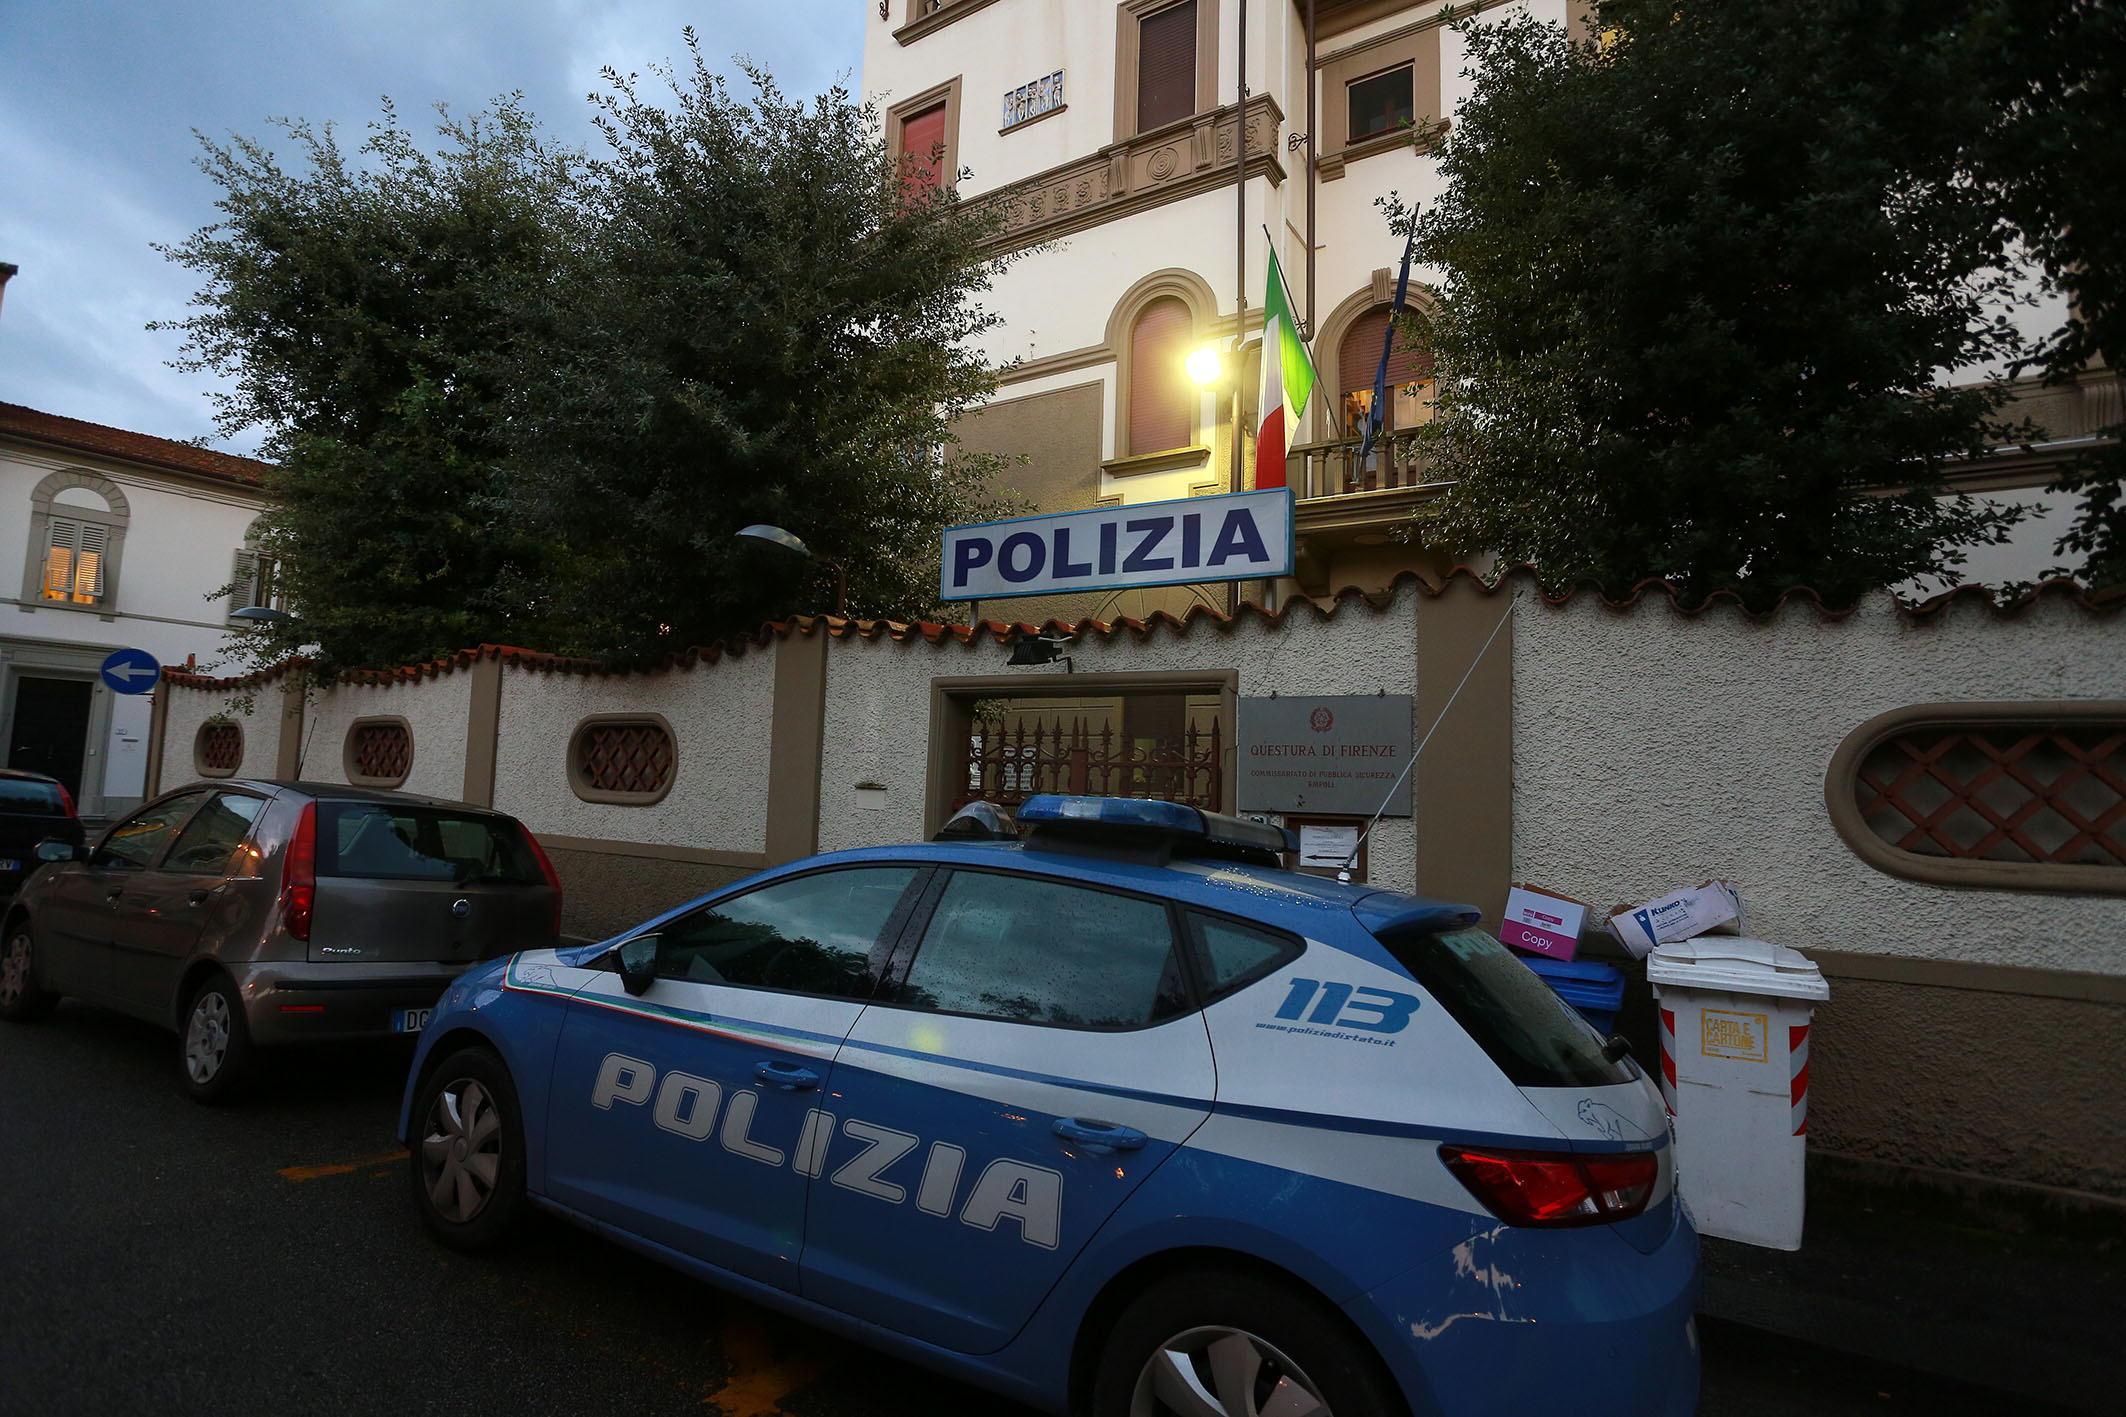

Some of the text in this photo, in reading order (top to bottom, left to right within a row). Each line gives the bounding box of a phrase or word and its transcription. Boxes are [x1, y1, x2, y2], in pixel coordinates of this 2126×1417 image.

[953, 508, 1270, 587] POLIZIA
[1250, 745, 1397, 758] QUESTURA DI FIRENZE
[1309, 770, 1316, 778] DI
[1319, 770, 1353, 779] PUBBLICA
[1355, 771, 1396, 780] SICUREZZA
[321, 947, 361, 955] Punto
[1521, 931, 1553, 950] Copy
[1274, 977, 1421, 1034] 113
[1256, 1023, 1397, 1048] www.poliziadistato.it
[591, 1051, 1064, 1251] POLIZIA
